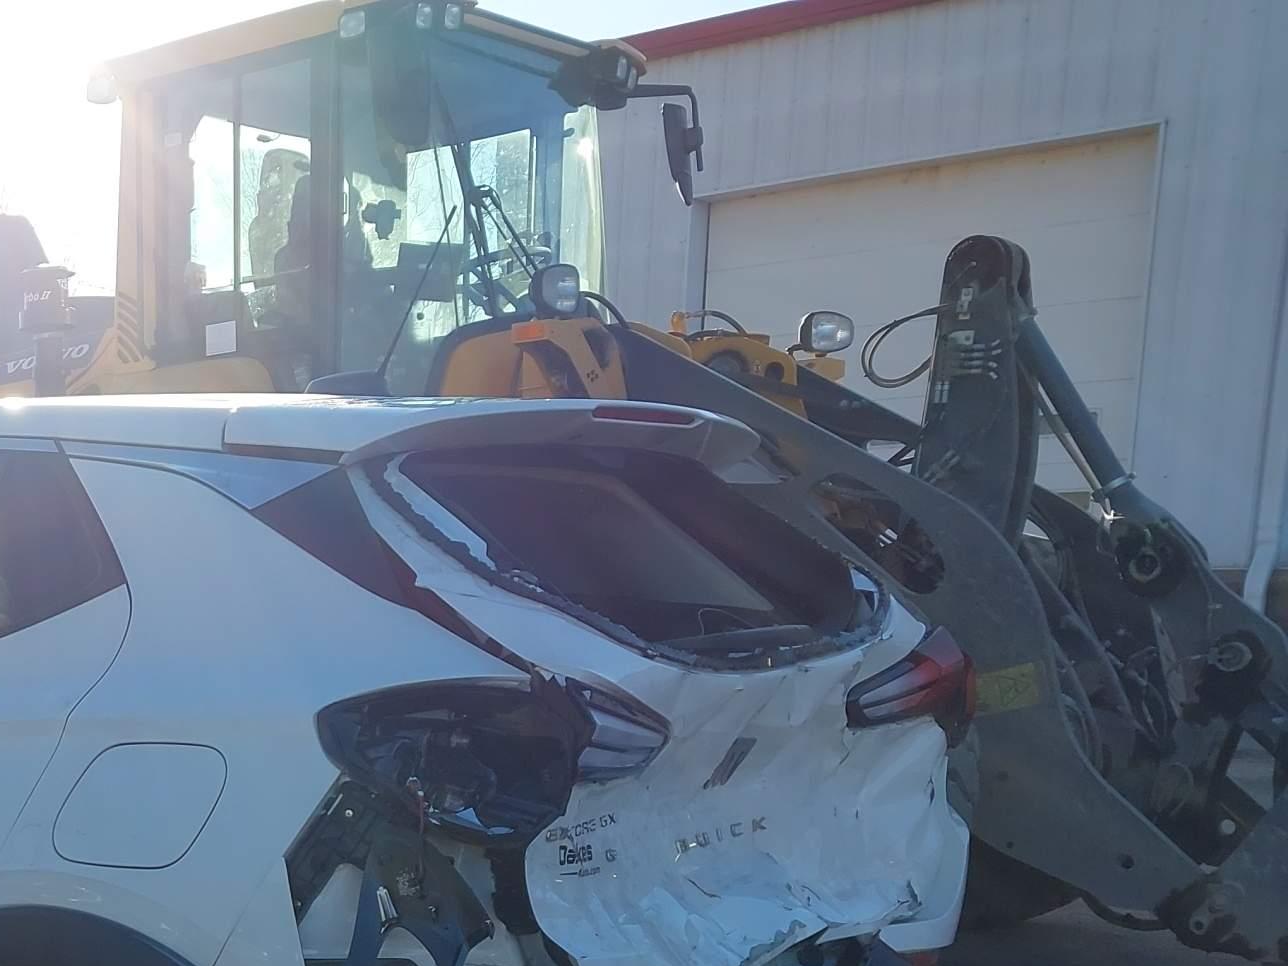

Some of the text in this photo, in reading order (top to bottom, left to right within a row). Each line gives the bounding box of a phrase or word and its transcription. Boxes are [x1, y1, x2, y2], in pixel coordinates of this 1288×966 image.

[6, 343, 90, 374] VOVO
[599, 811, 617, 829] GX
[674, 816, 768, 854] BUICK
